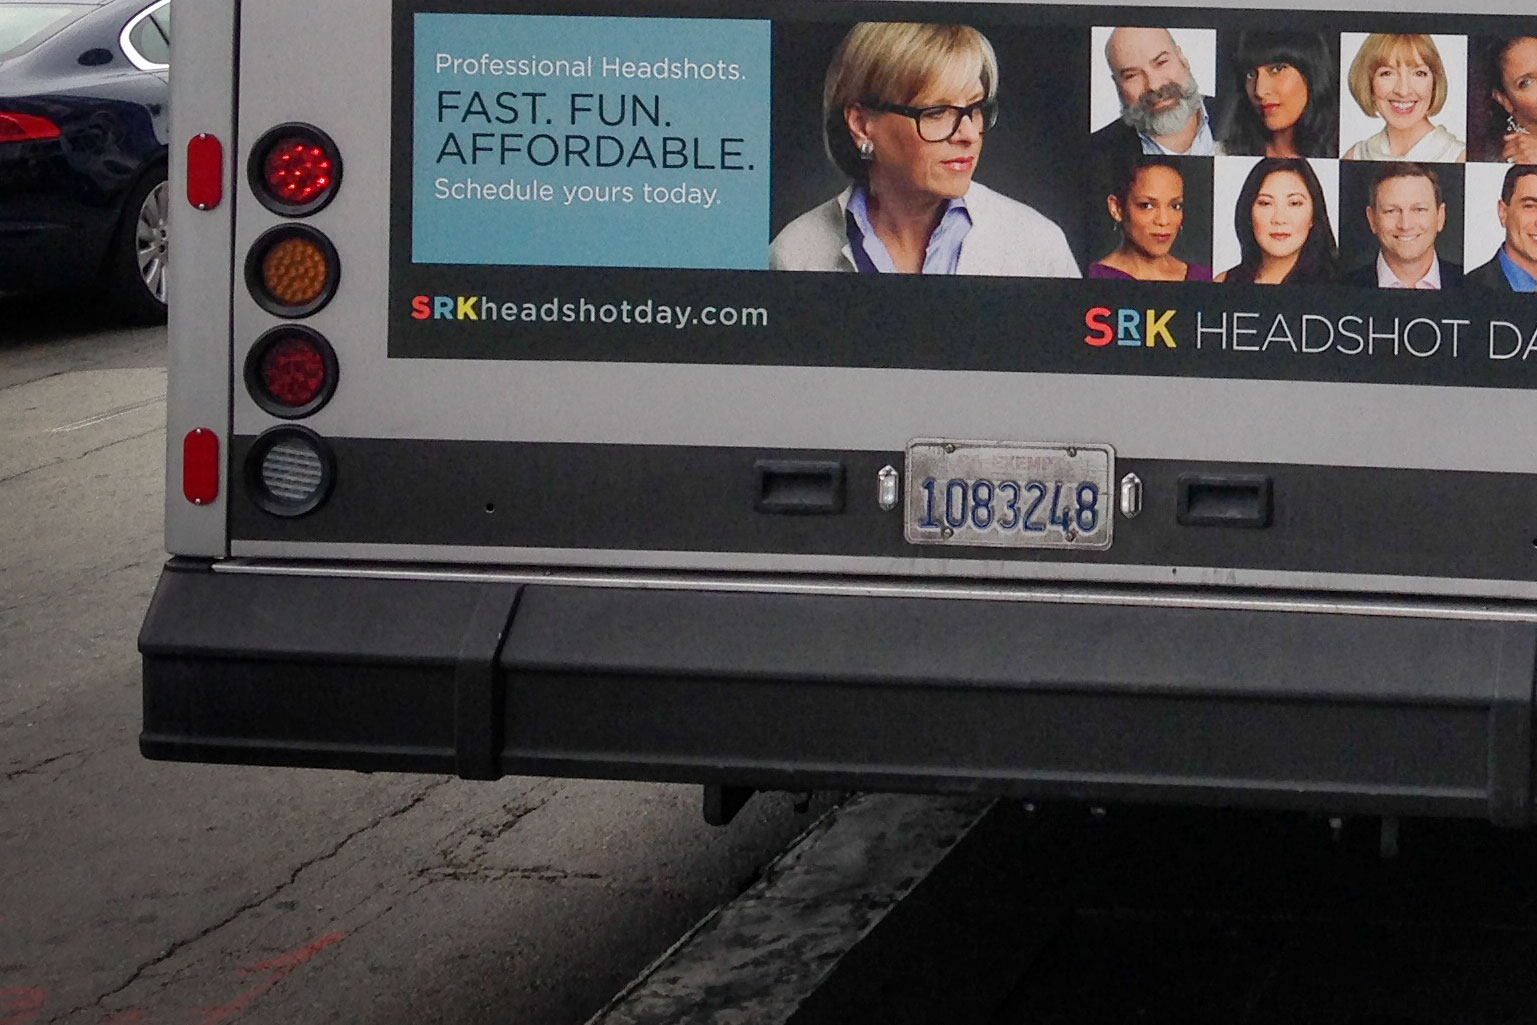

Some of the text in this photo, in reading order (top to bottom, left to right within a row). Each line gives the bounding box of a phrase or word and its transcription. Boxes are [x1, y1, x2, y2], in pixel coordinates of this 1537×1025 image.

[435, 53, 747, 81] Professional Headshots.
[437, 91, 672, 127] FAST. FUN.
[436, 133, 756, 171] AFFORDABLE.
[434, 178, 722, 208] Schedule yours today.
[411, 295, 769, 329] SRKheadshotday.com
[1083, 306, 1177, 348] SRK
[1196, 312, 1471, 359] HEADSHOT
[918, 478, 1098, 533] 1083248
